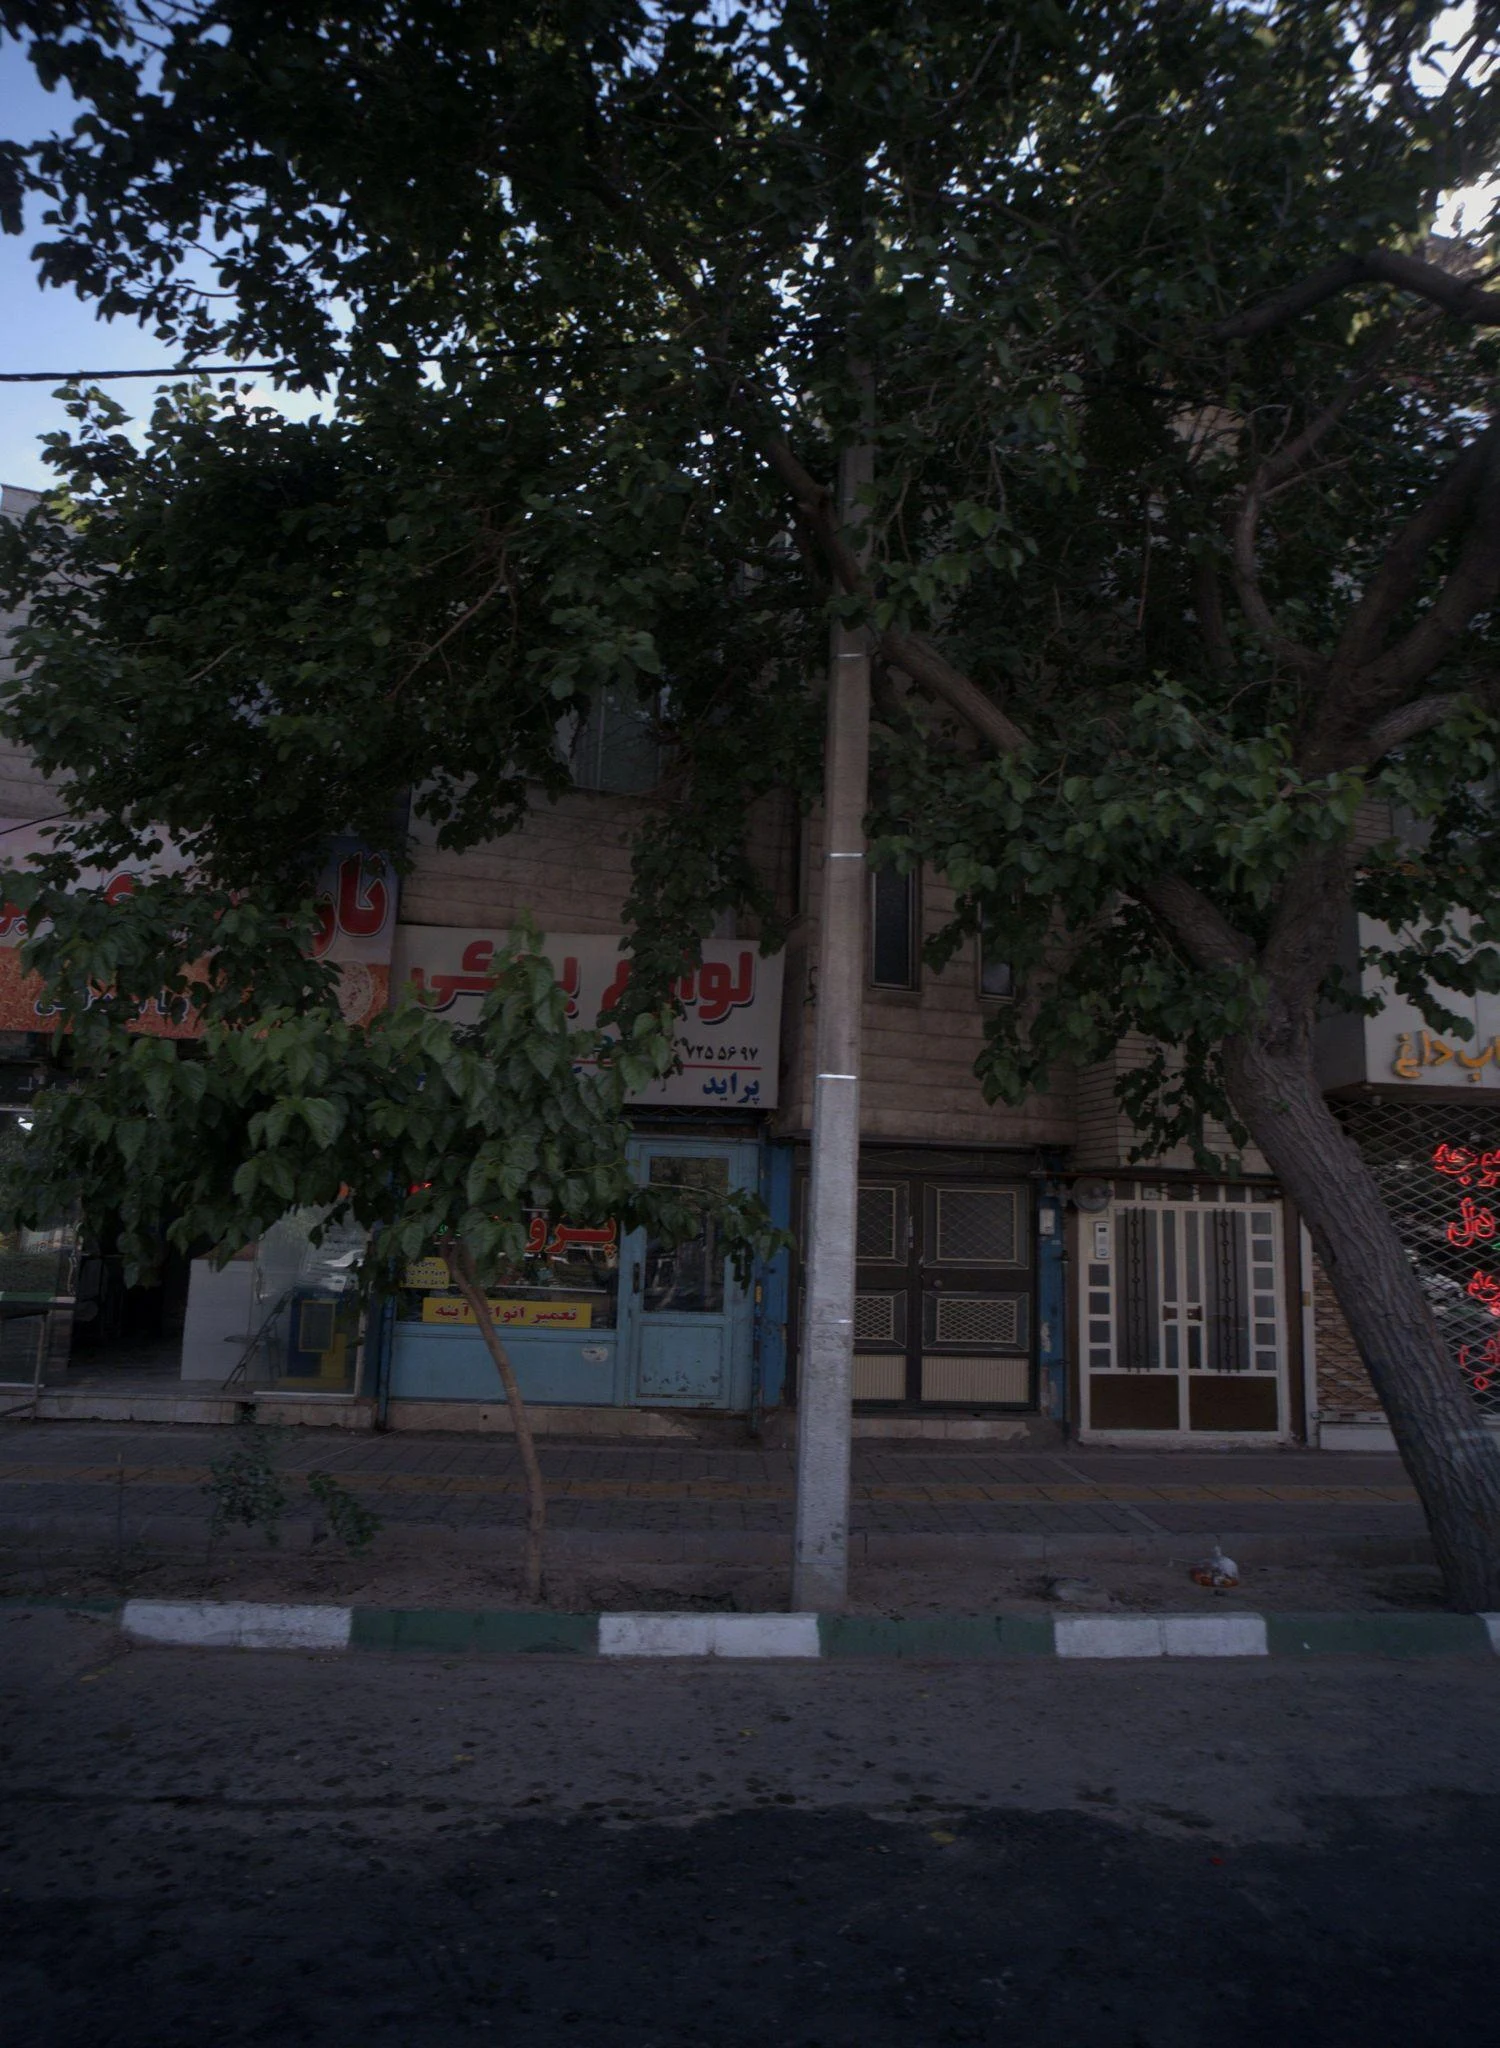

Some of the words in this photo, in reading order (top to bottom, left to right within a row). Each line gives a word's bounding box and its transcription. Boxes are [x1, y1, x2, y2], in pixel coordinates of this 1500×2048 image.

[702, 1071, 760, 1105] پراید
[487, 1305, 525, 1323] انوا
[530, 1307, 577, 1324] تعمیر
